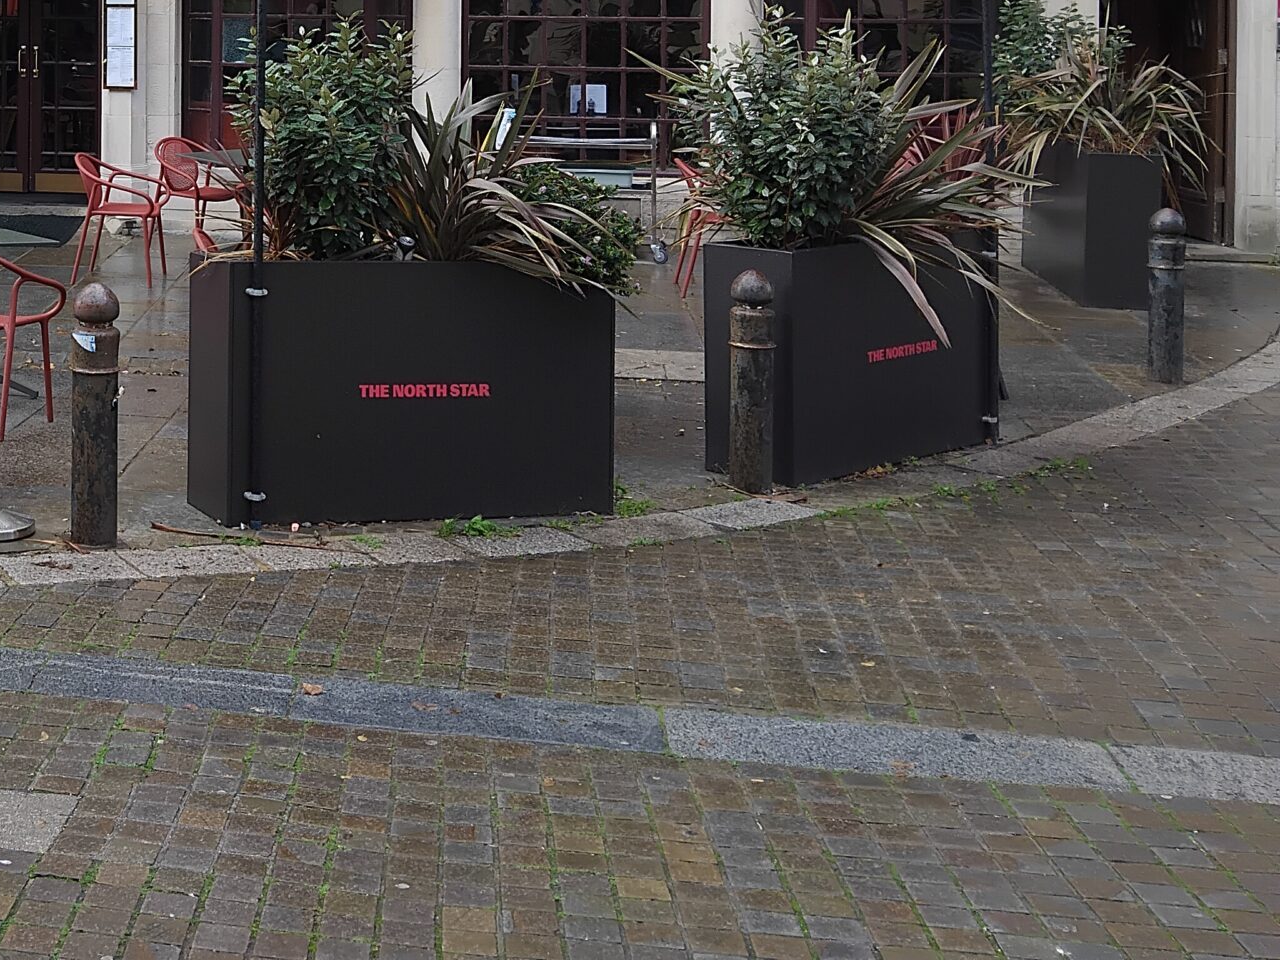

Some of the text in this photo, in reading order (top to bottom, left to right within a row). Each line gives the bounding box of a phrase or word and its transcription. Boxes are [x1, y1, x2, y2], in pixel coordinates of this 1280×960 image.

[867, 339, 938, 363] THE NORTH STAR
[358, 383, 490, 398] THE NORTH STAR
